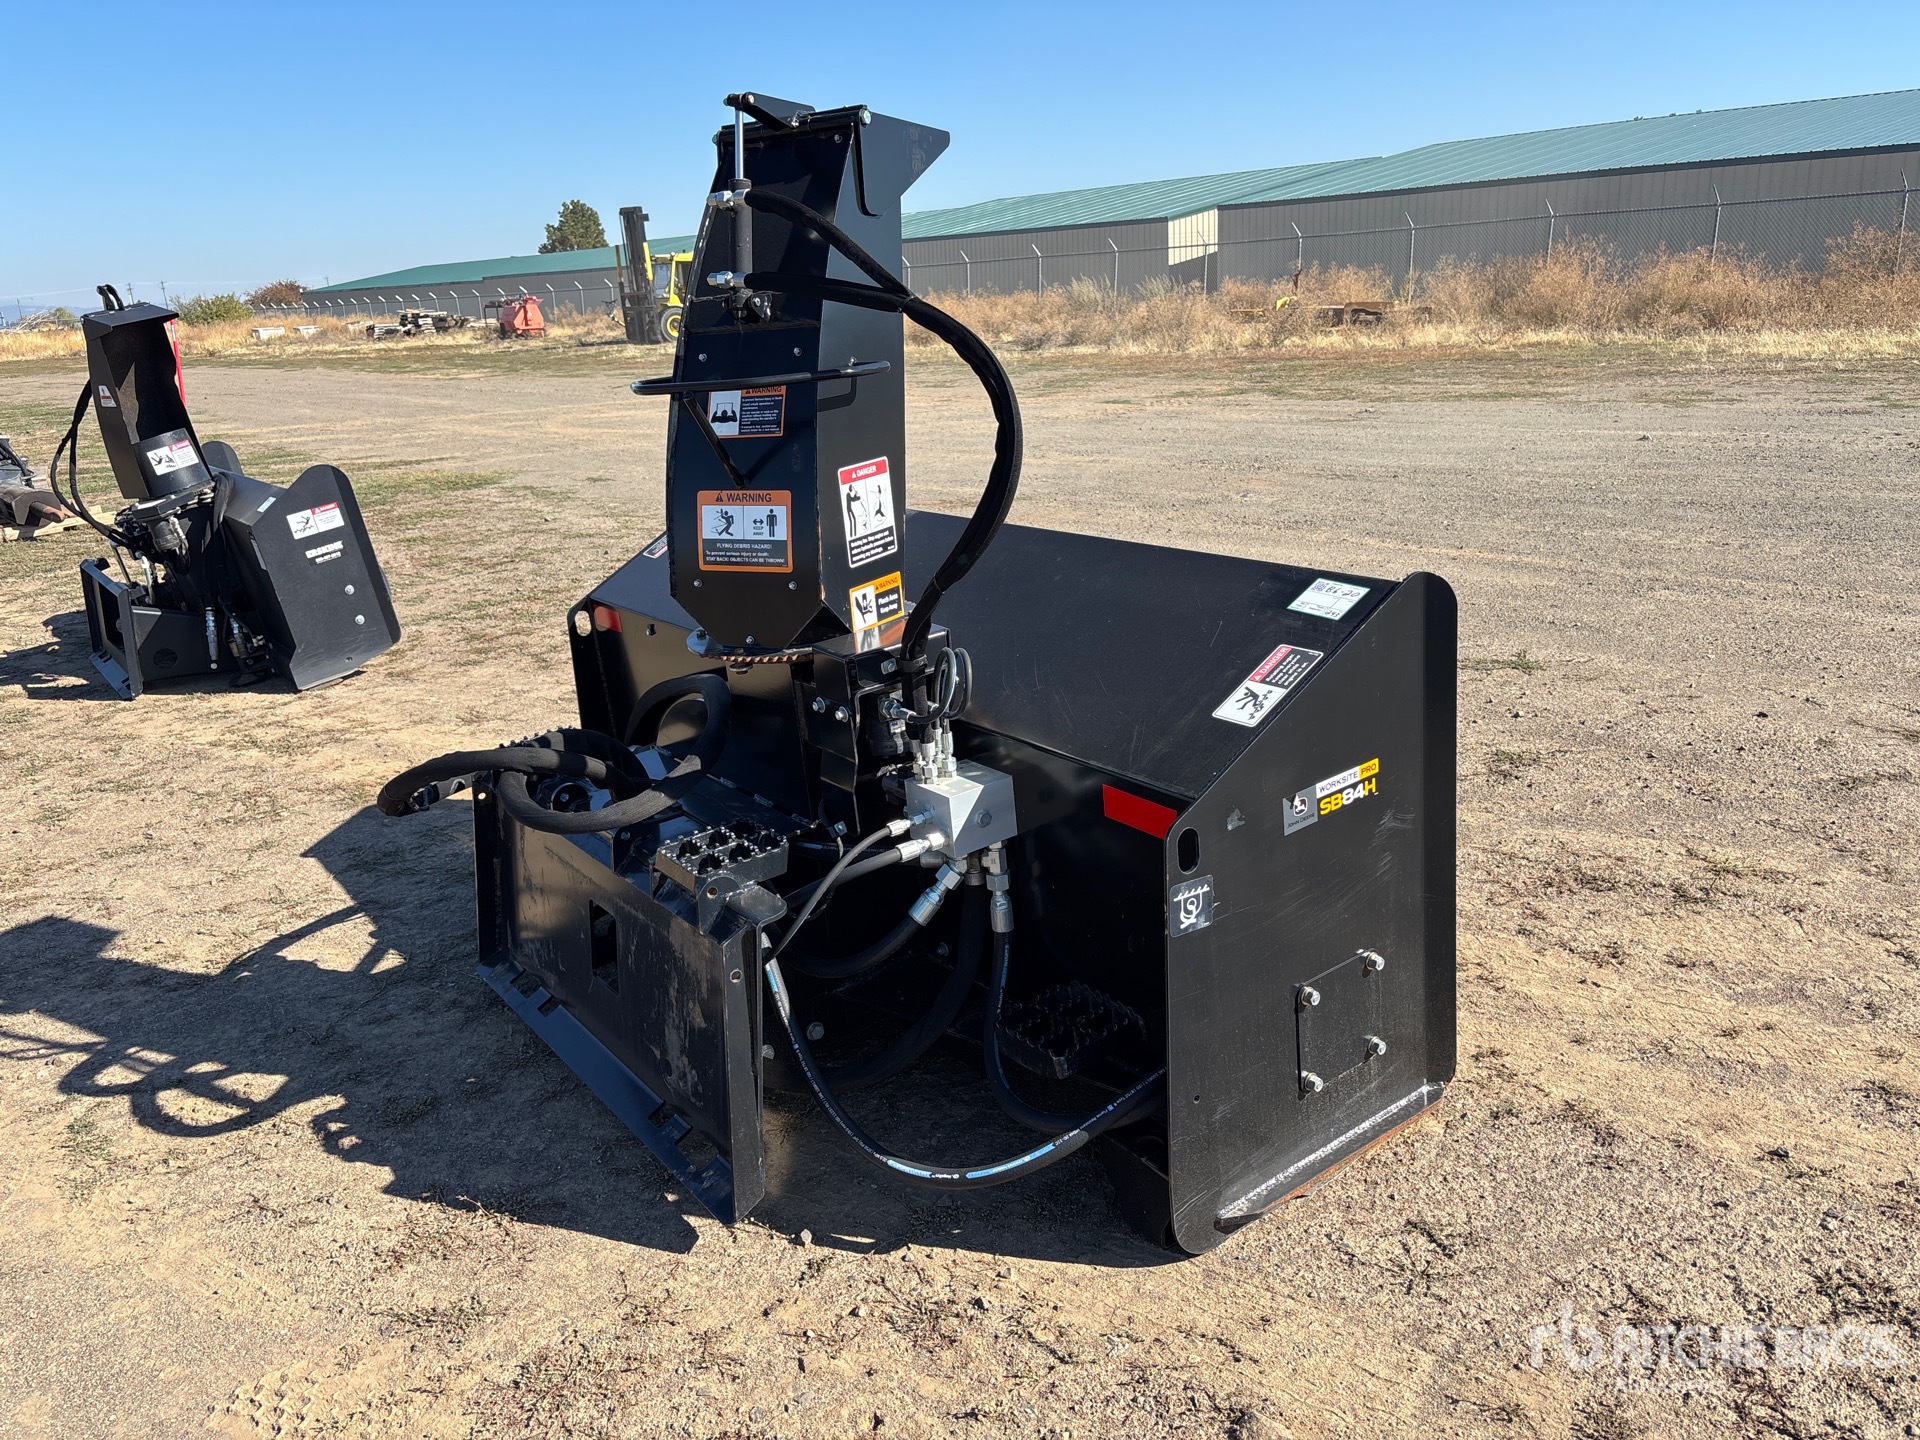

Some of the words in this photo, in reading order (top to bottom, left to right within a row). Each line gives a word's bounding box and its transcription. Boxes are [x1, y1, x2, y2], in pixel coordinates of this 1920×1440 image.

[752, 386, 782, 394] WARNING
[856, 465, 876, 477] DANGER
[726, 493, 772, 502] WARNING
[1259, 647, 1289, 673] DANGER
[1319, 770, 1359, 793] WORKSITE
[1361, 763, 1377, 776] PRO
[1320, 777, 1376, 815] SB84H
[1287, 820, 1300, 829] JOHN
[1300, 812, 1315, 823] DEERE
